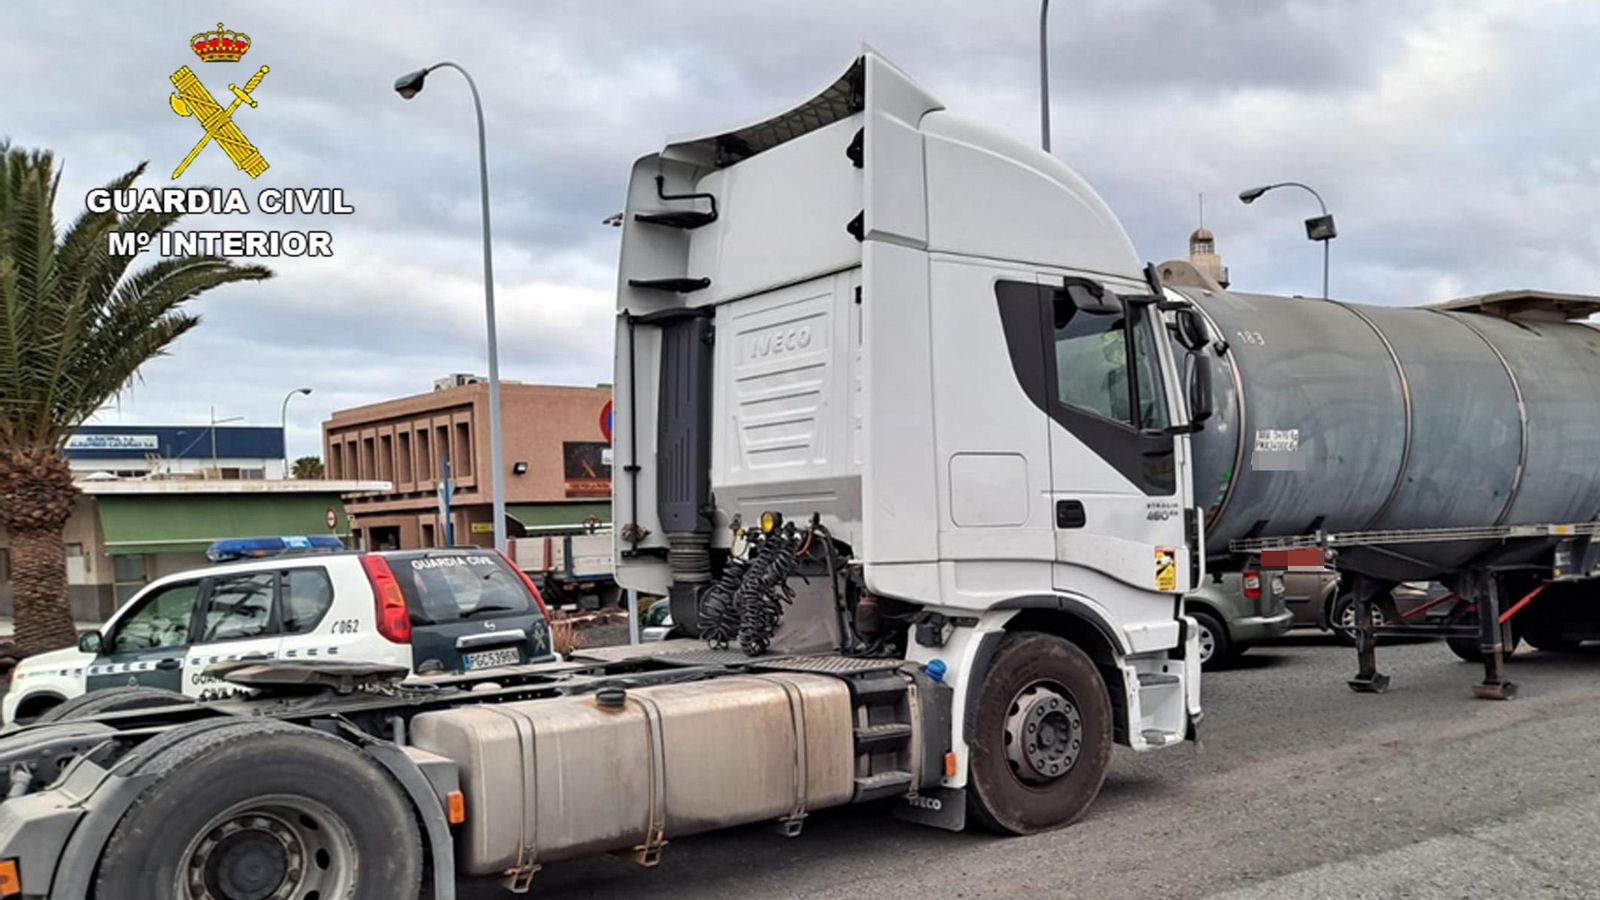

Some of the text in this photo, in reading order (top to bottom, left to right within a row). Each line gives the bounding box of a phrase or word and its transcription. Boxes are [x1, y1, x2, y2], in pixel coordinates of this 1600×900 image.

[751, 329, 812, 359] IVECO
[1236, 330, 1265, 346] 183
[410, 555, 496, 571] GUARDIA CIVIL
[339, 618, 360, 634] 062
